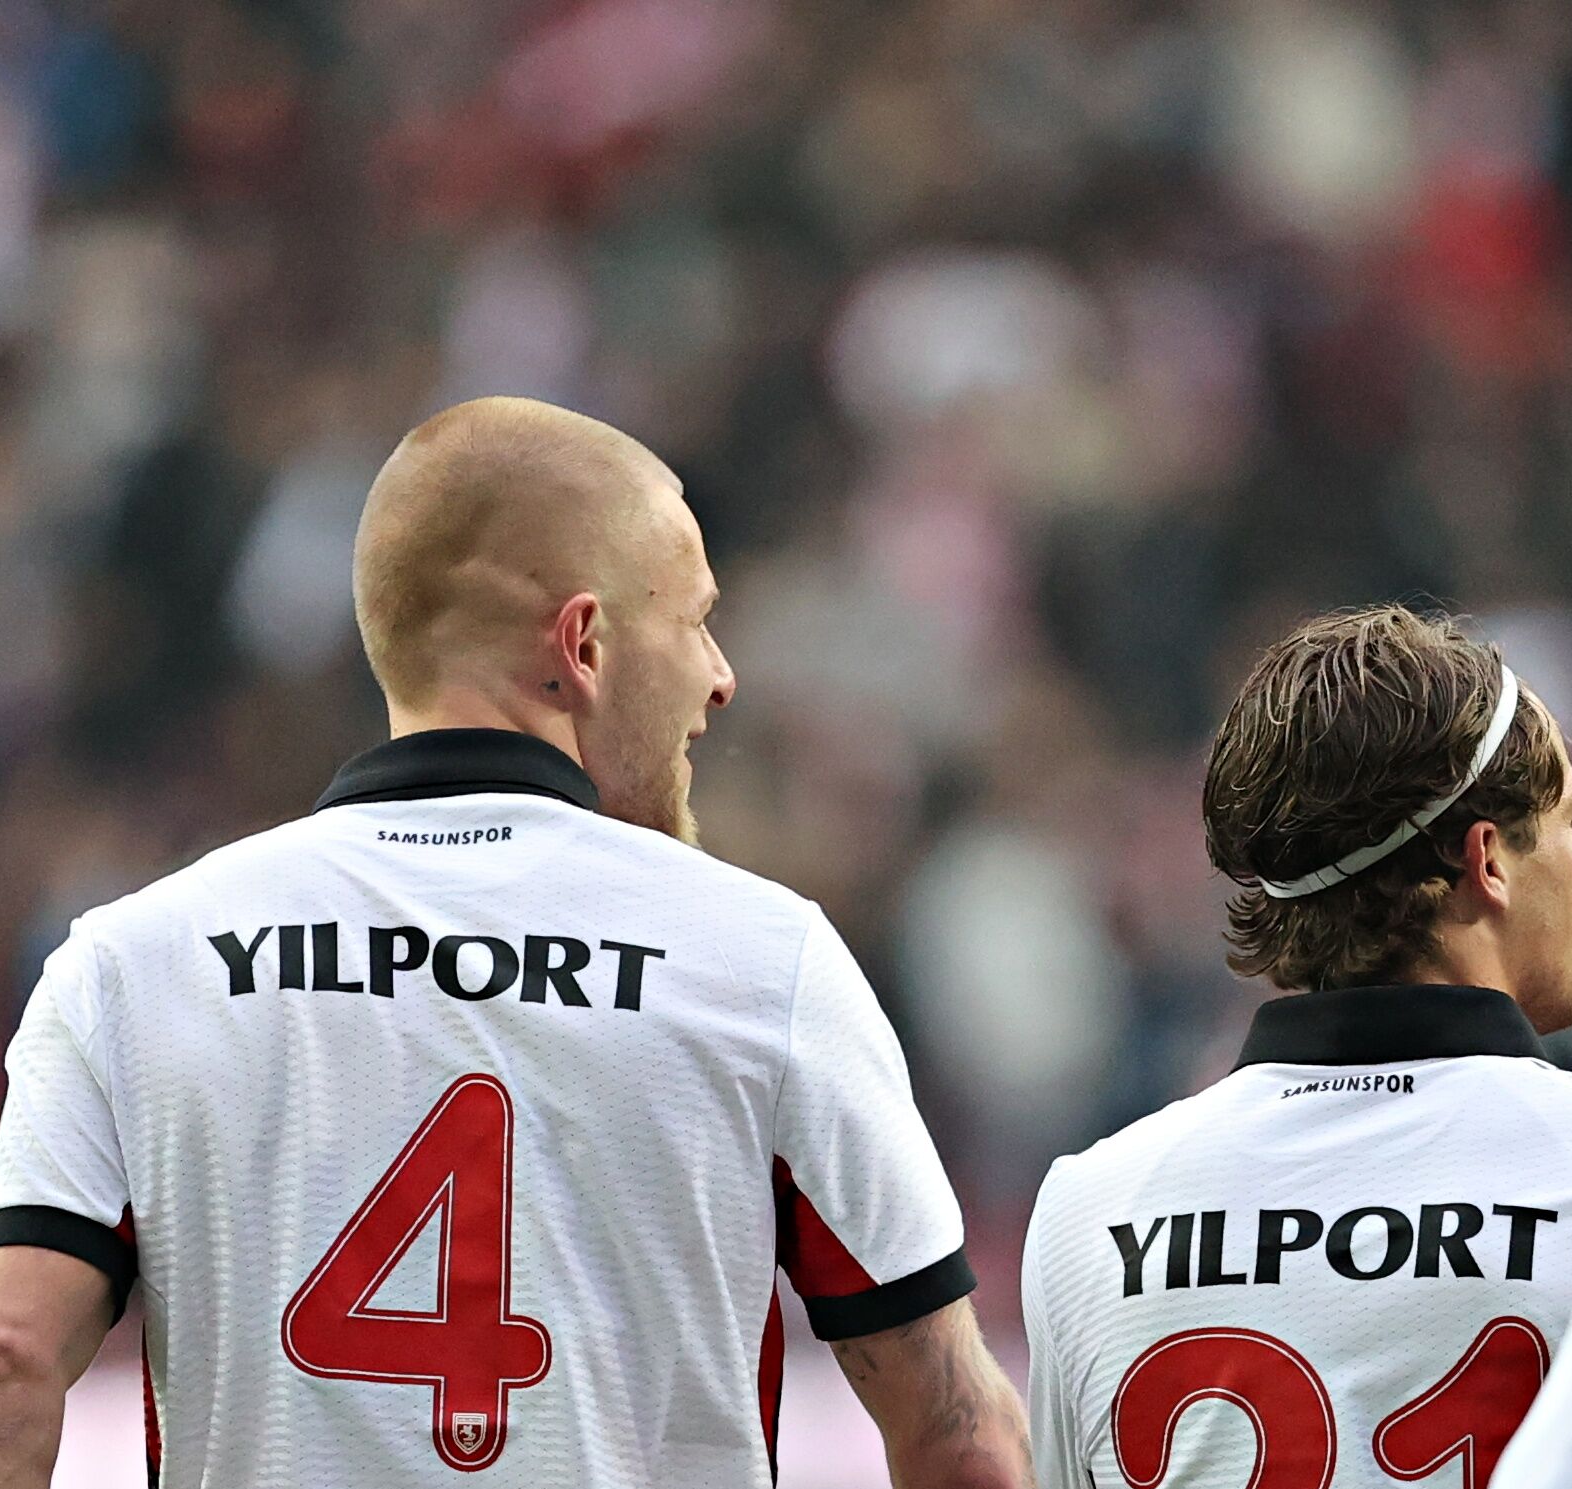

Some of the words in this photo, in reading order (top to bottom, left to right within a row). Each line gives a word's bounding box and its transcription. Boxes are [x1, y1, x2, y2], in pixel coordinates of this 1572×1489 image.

[377, 826, 512, 845] SAMSUNSPOR
[207, 921, 666, 1012] YILPORT
[1281, 1074, 1415, 1099] SAMSUNSPOR
[281, 1072, 553, 1473] 4
[1107, 1202, 1559, 1299] YILPORT
